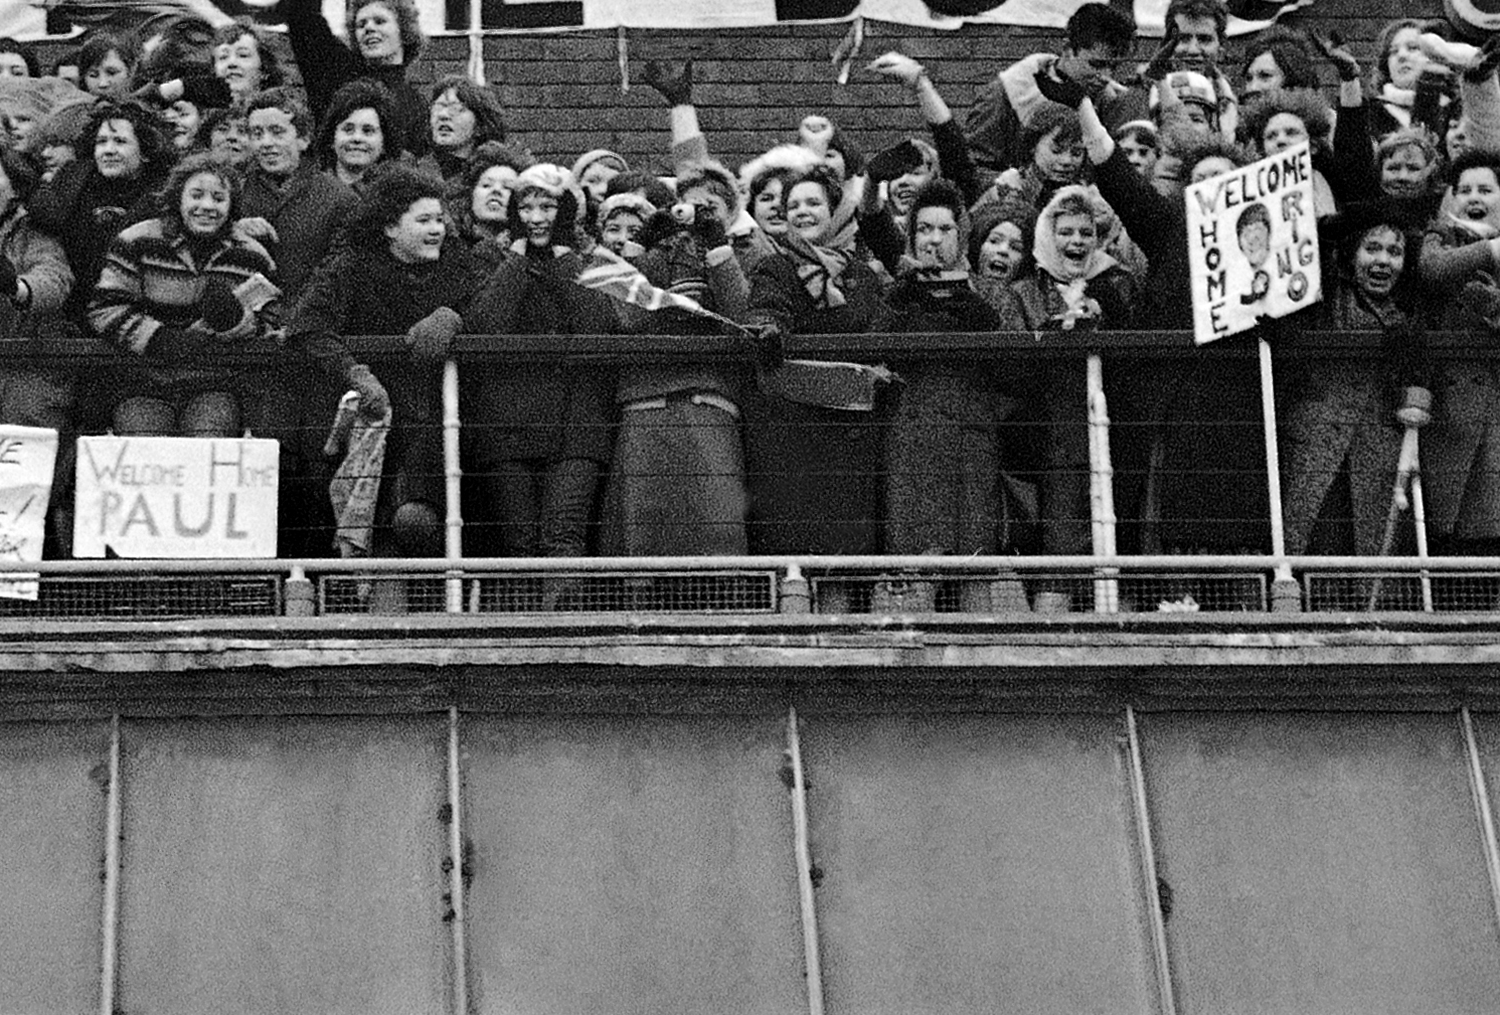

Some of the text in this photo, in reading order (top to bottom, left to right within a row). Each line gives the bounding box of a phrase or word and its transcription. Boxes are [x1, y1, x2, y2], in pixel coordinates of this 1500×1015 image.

[1195, 150, 1309, 216] WELCOME
[1200, 219, 1228, 333] HOME
[1276, 191, 1314, 303] RINGO
[100, 490, 249, 540] PAUL
